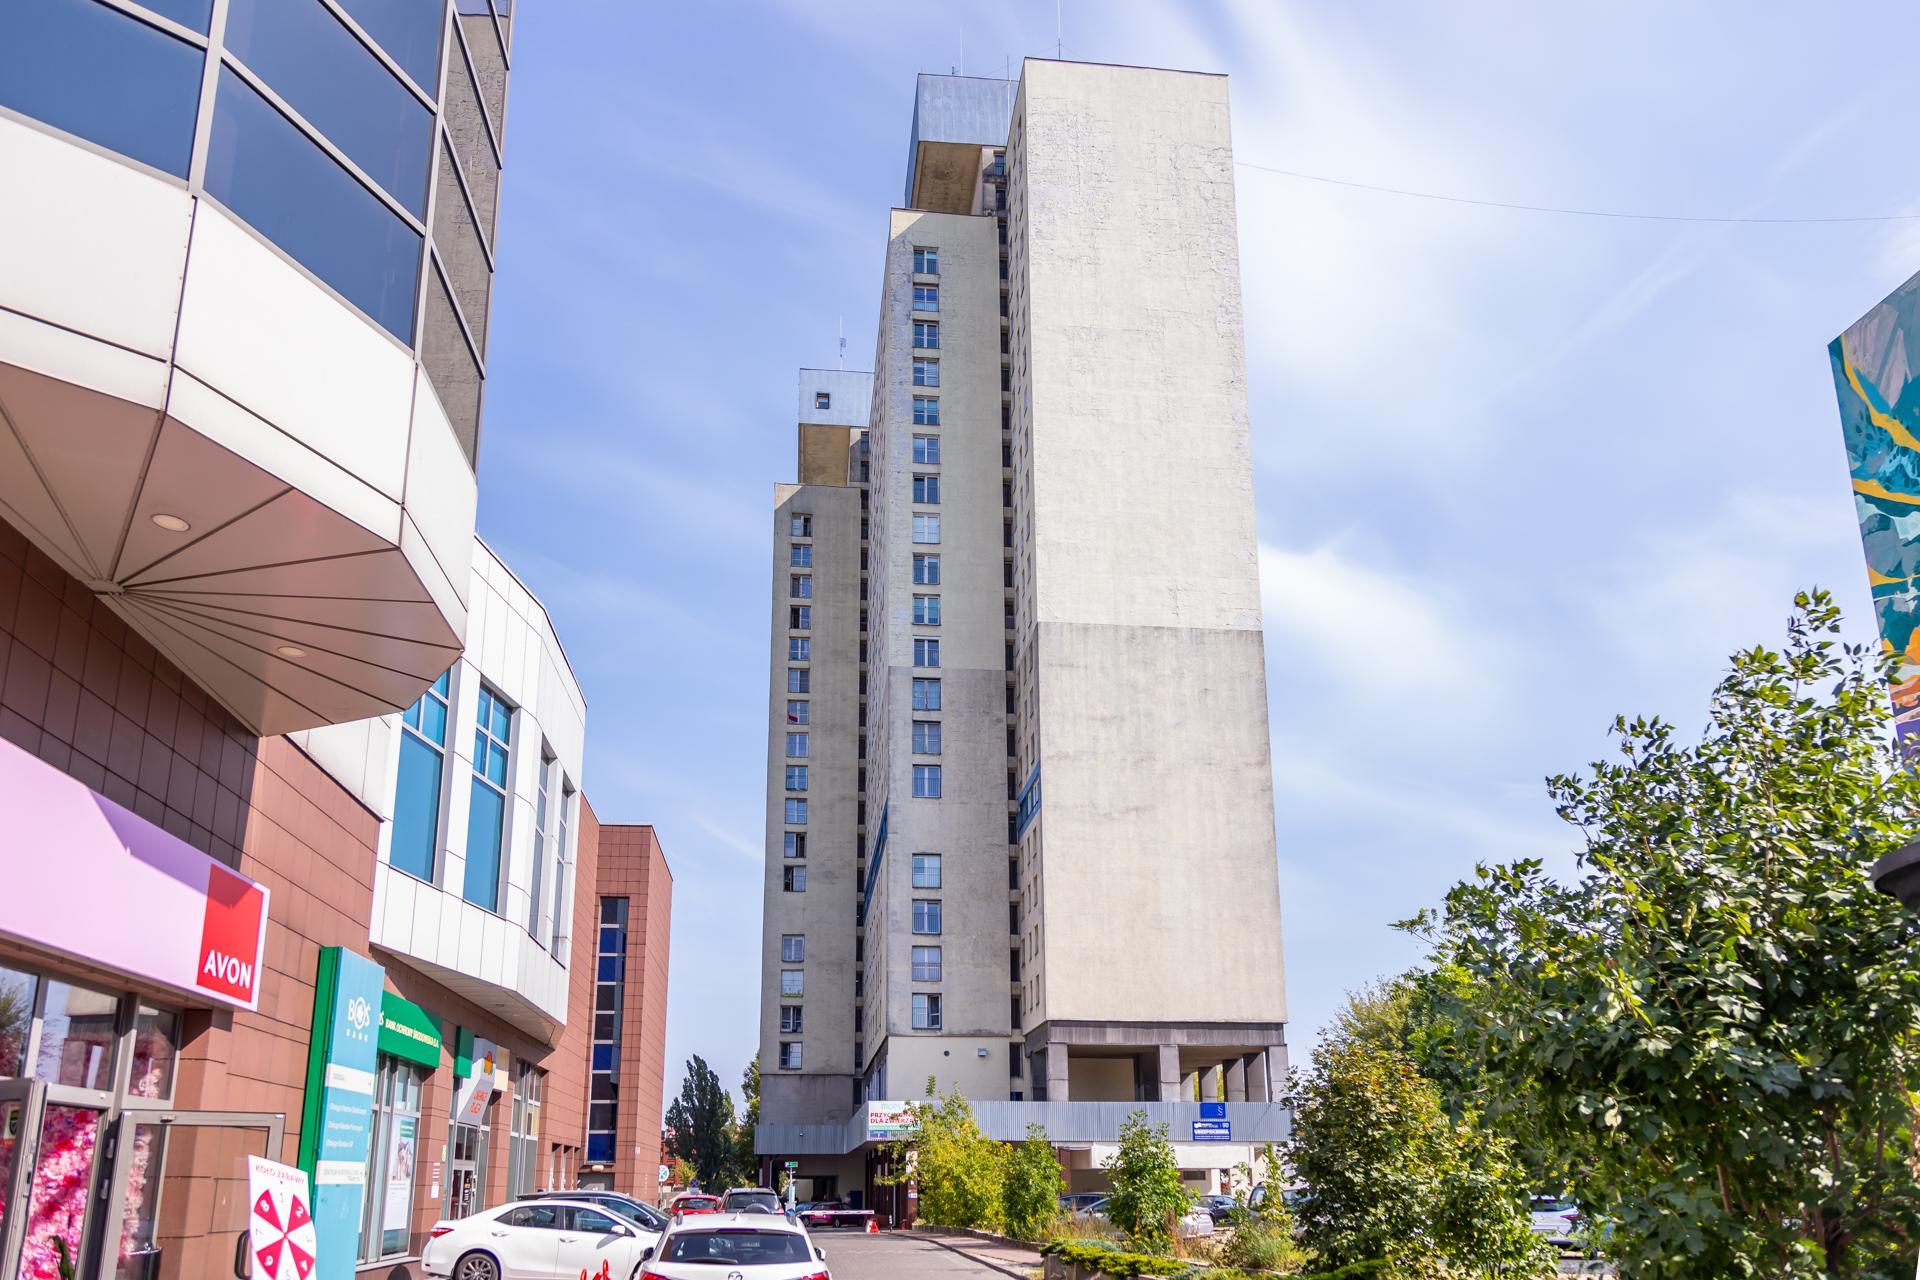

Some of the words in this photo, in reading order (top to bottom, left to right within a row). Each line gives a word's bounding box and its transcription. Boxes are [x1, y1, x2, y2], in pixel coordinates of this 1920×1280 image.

[203, 949, 252, 989] AVON
[348, 996, 371, 1030] BOŚ
[277, 1170, 305, 1184] ZABAWY
[260, 1199, 270, 1213] 8
[295, 1206, 305, 1218] 2
